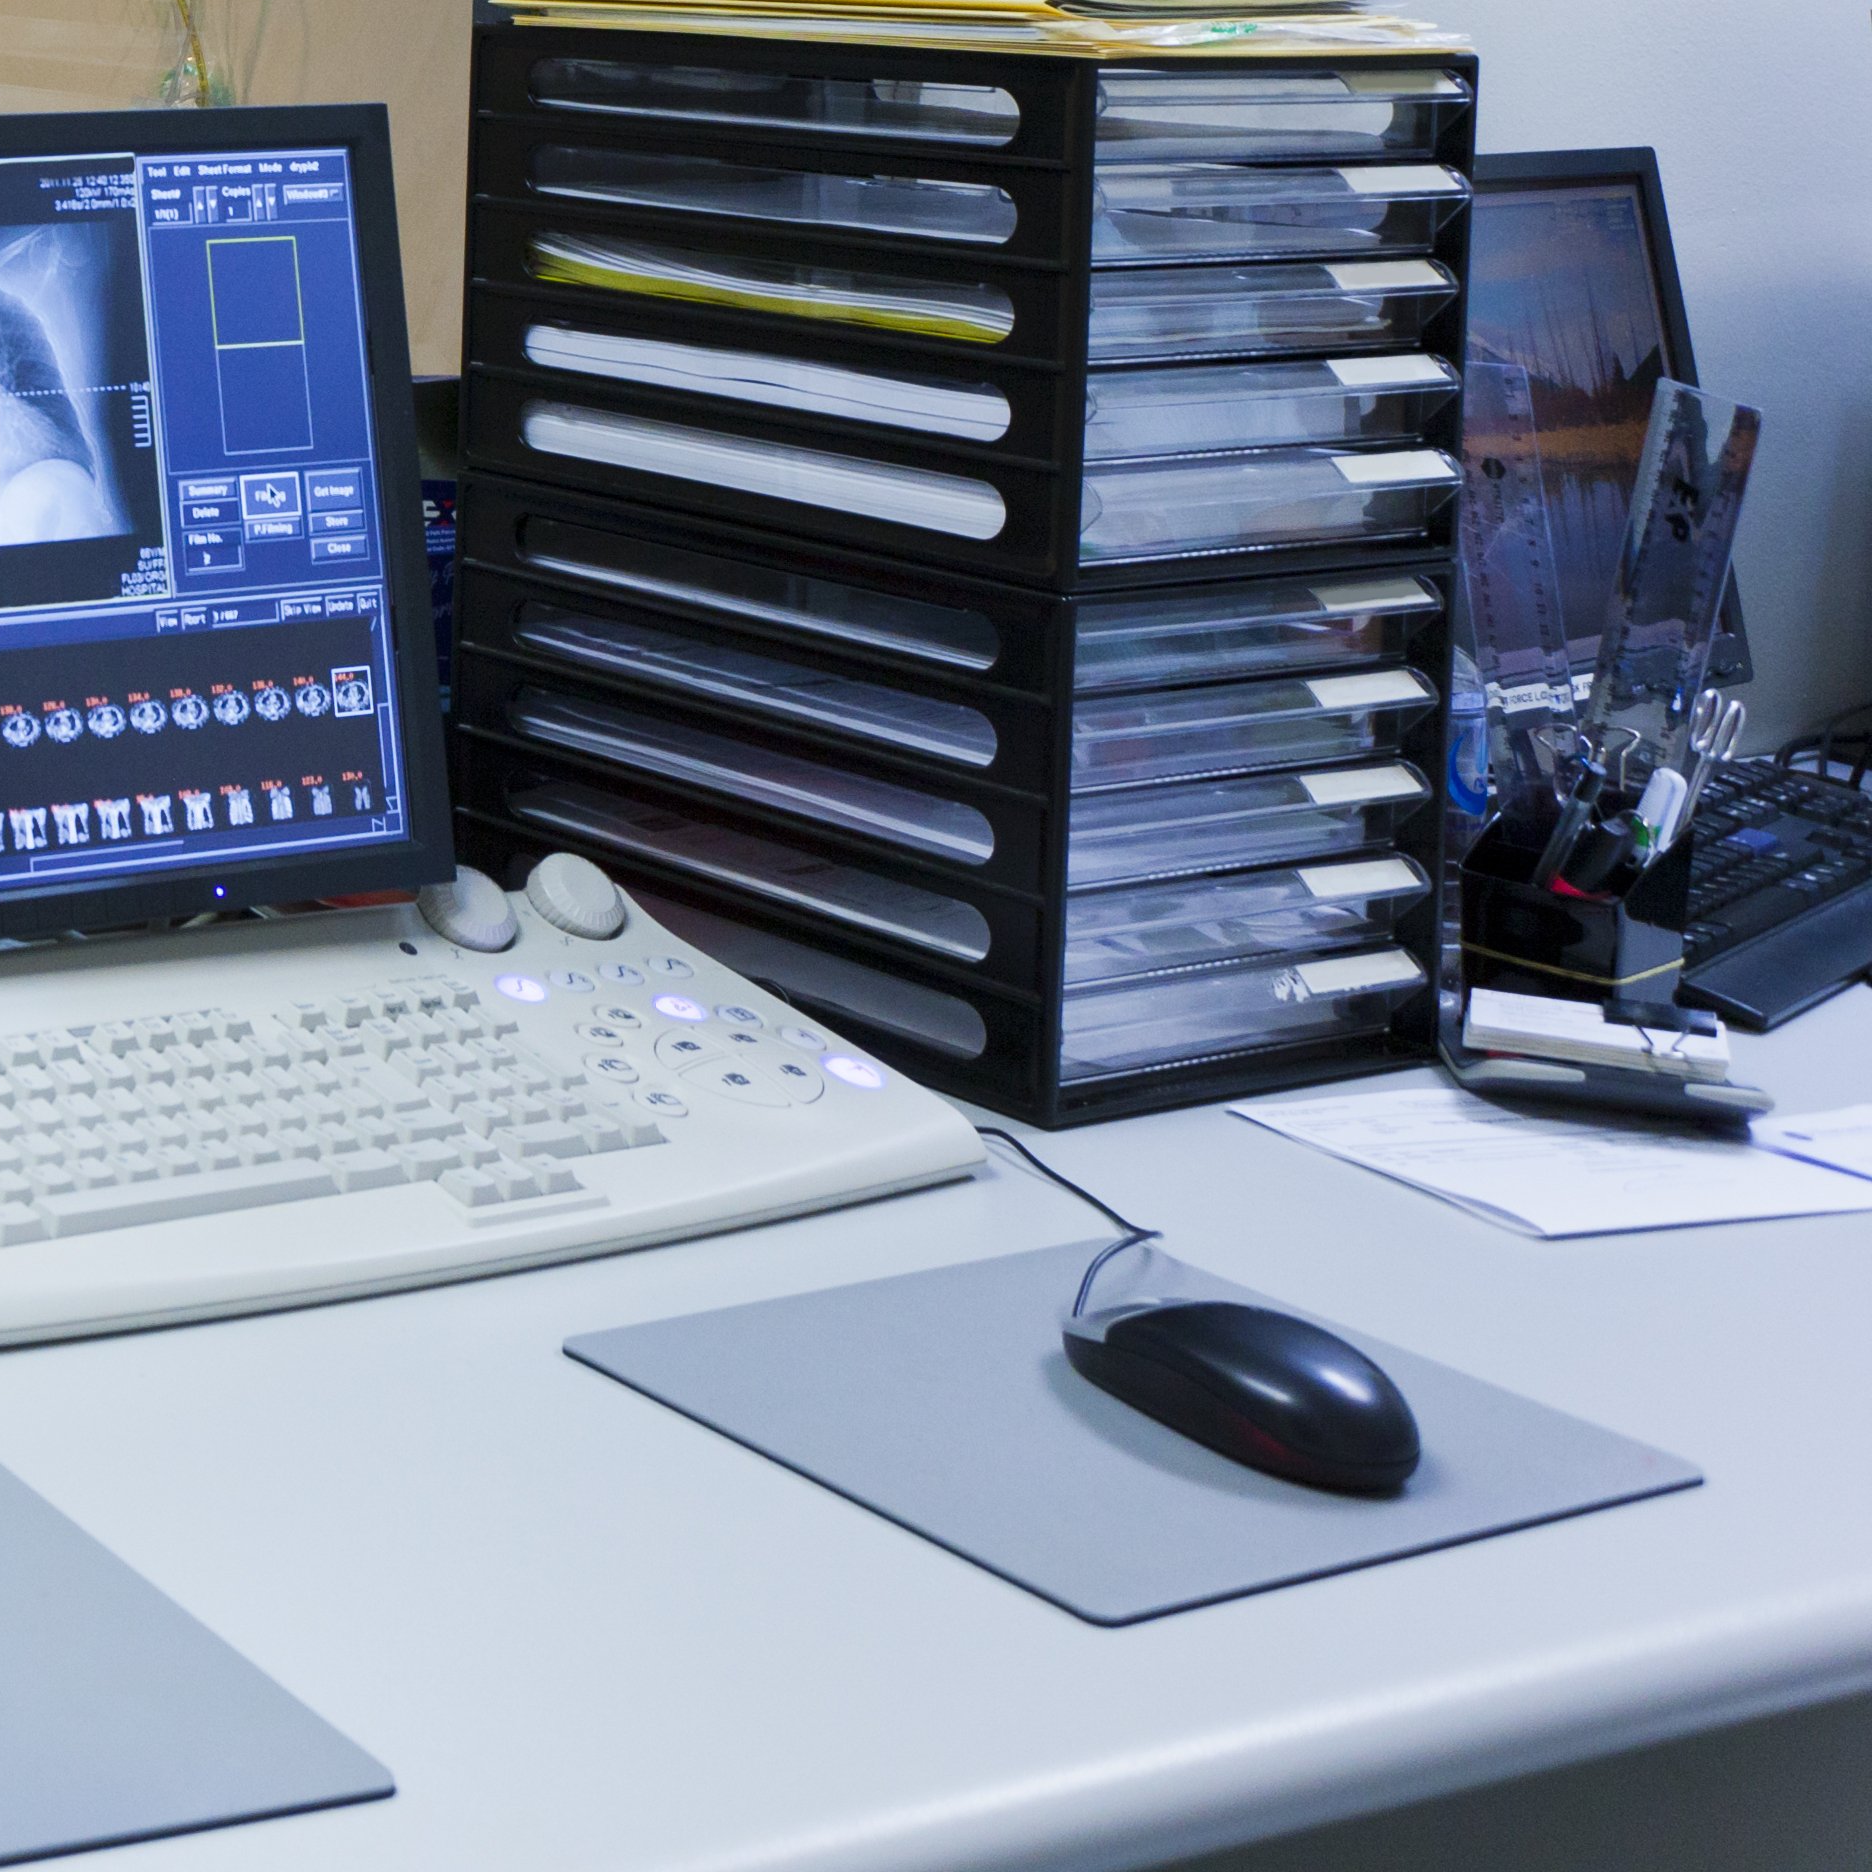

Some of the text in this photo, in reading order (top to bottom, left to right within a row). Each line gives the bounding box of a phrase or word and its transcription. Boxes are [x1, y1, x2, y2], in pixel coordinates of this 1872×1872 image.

[147, 166, 167, 178] Tool
[173, 165, 191, 177] Edit
[198, 164, 222, 176] Sheet
[222, 164, 252, 175] Format
[258, 162, 282, 173] Mode
[221, 185, 251, 198] Copies
[188, 484, 228, 498] Summary
[329, 484, 354, 497] Image
[192, 507, 220, 519] Delete
[325, 516, 349, 527] Store
[188, 534, 205, 545] Film
[327, 542, 351, 554] Close
